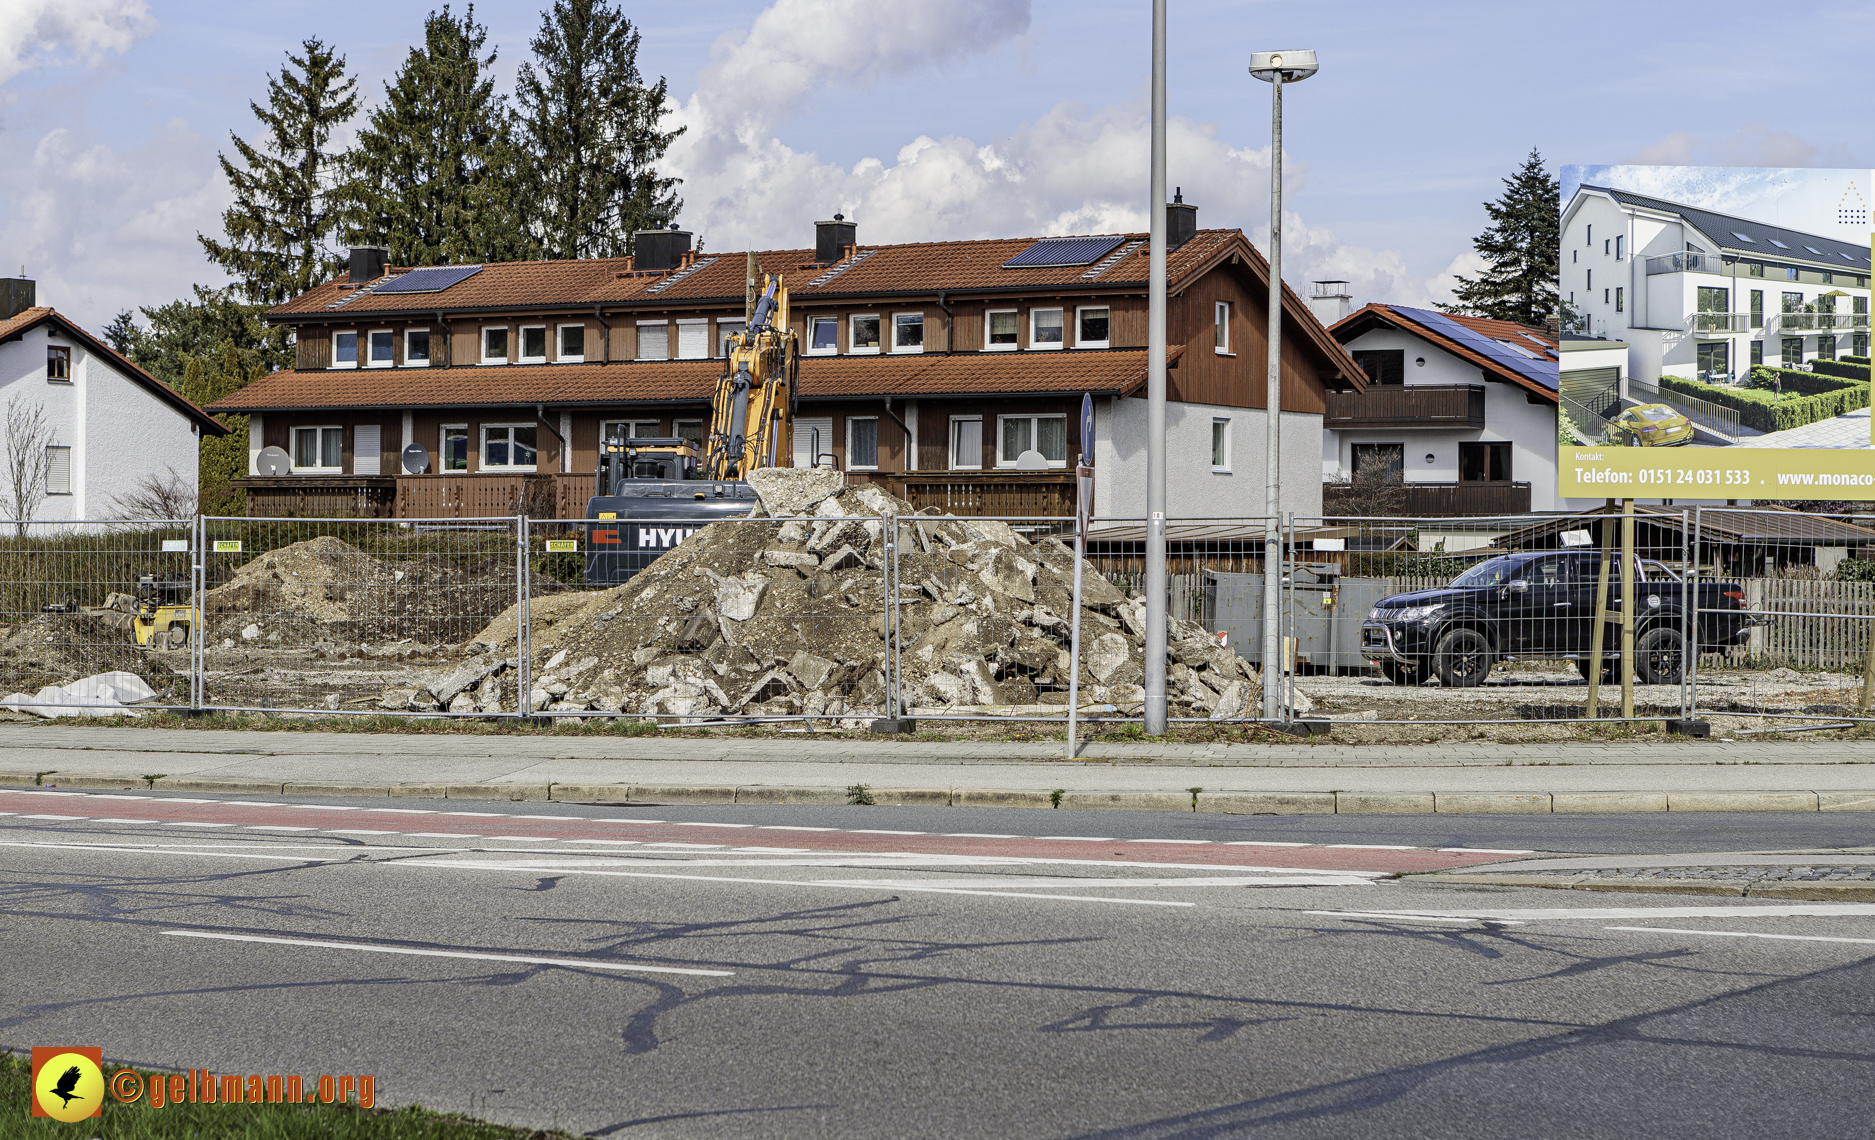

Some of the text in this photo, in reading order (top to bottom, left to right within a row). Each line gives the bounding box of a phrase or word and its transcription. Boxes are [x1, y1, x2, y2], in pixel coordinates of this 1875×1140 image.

[1575, 452, 1604, 461] Kontakt:
[1575, 467, 1633, 484] Telefon:
[1639, 469, 1672, 484] 0151
[1676, 469, 1693, 484] 24
[1696, 469, 1721, 485] 031
[1725, 469, 1750, 485] 533
[1777, 473, 1875, 486] www.monaco
[639, 528, 702, 548] HYU
